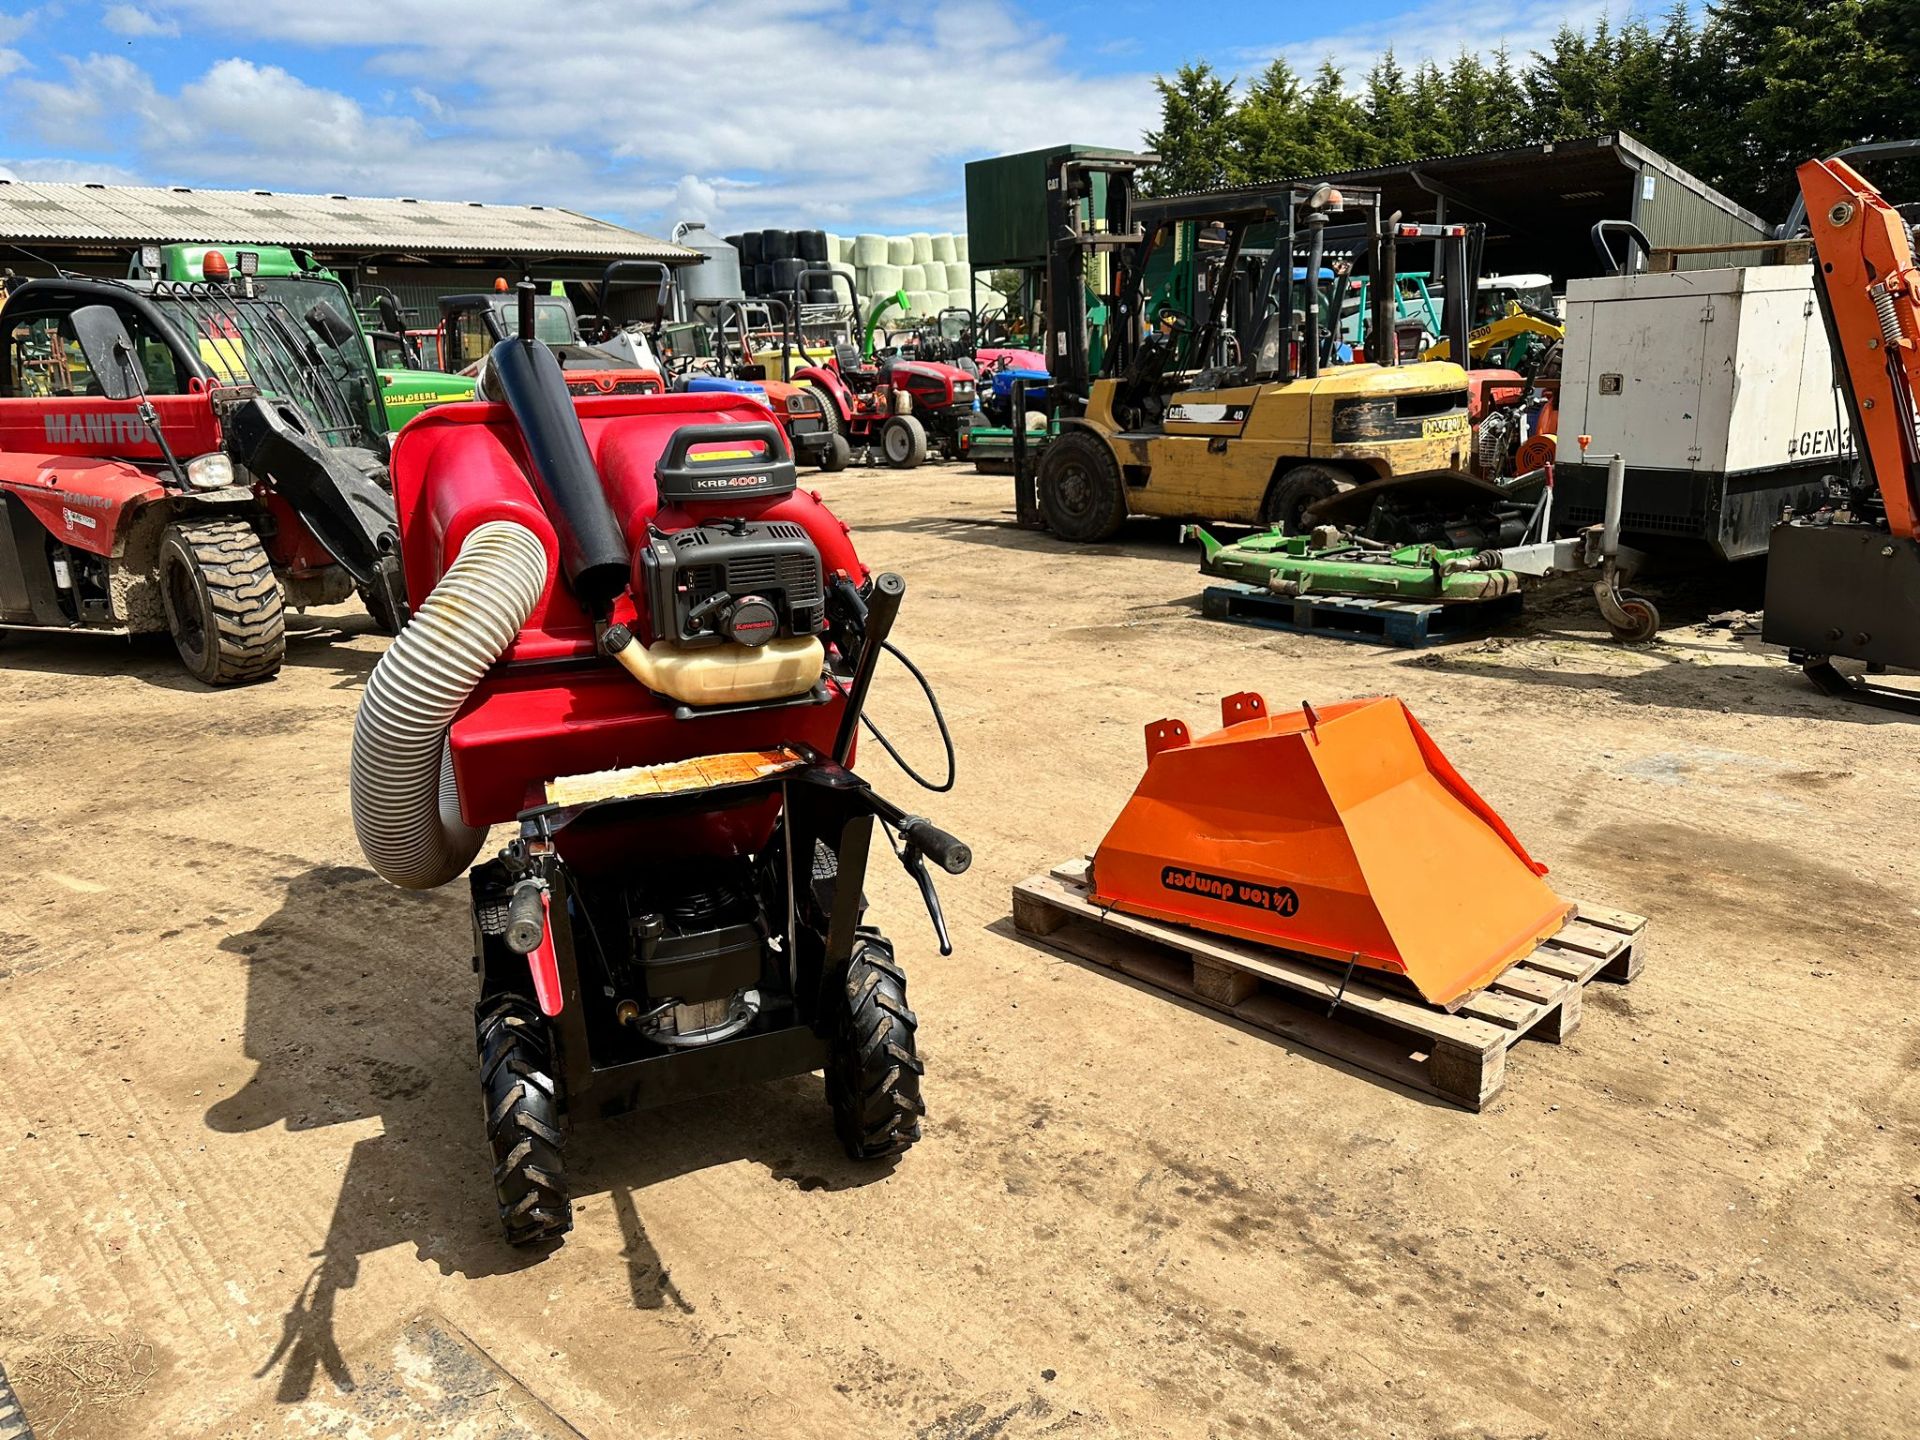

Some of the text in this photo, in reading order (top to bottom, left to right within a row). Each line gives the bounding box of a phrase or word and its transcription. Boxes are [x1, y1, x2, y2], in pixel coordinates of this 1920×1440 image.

[384, 394, 404, 403] OHN
[407, 392, 436, 401] DEERE
[1233, 410, 1244, 420] 40
[1800, 428, 1837, 456] GEN
[697, 476, 767, 489] KRB400B
[735, 620, 773, 630] Kawasaki
[1165, 871, 1235, 901] dumper
[1239, 886, 1271, 909] ton
